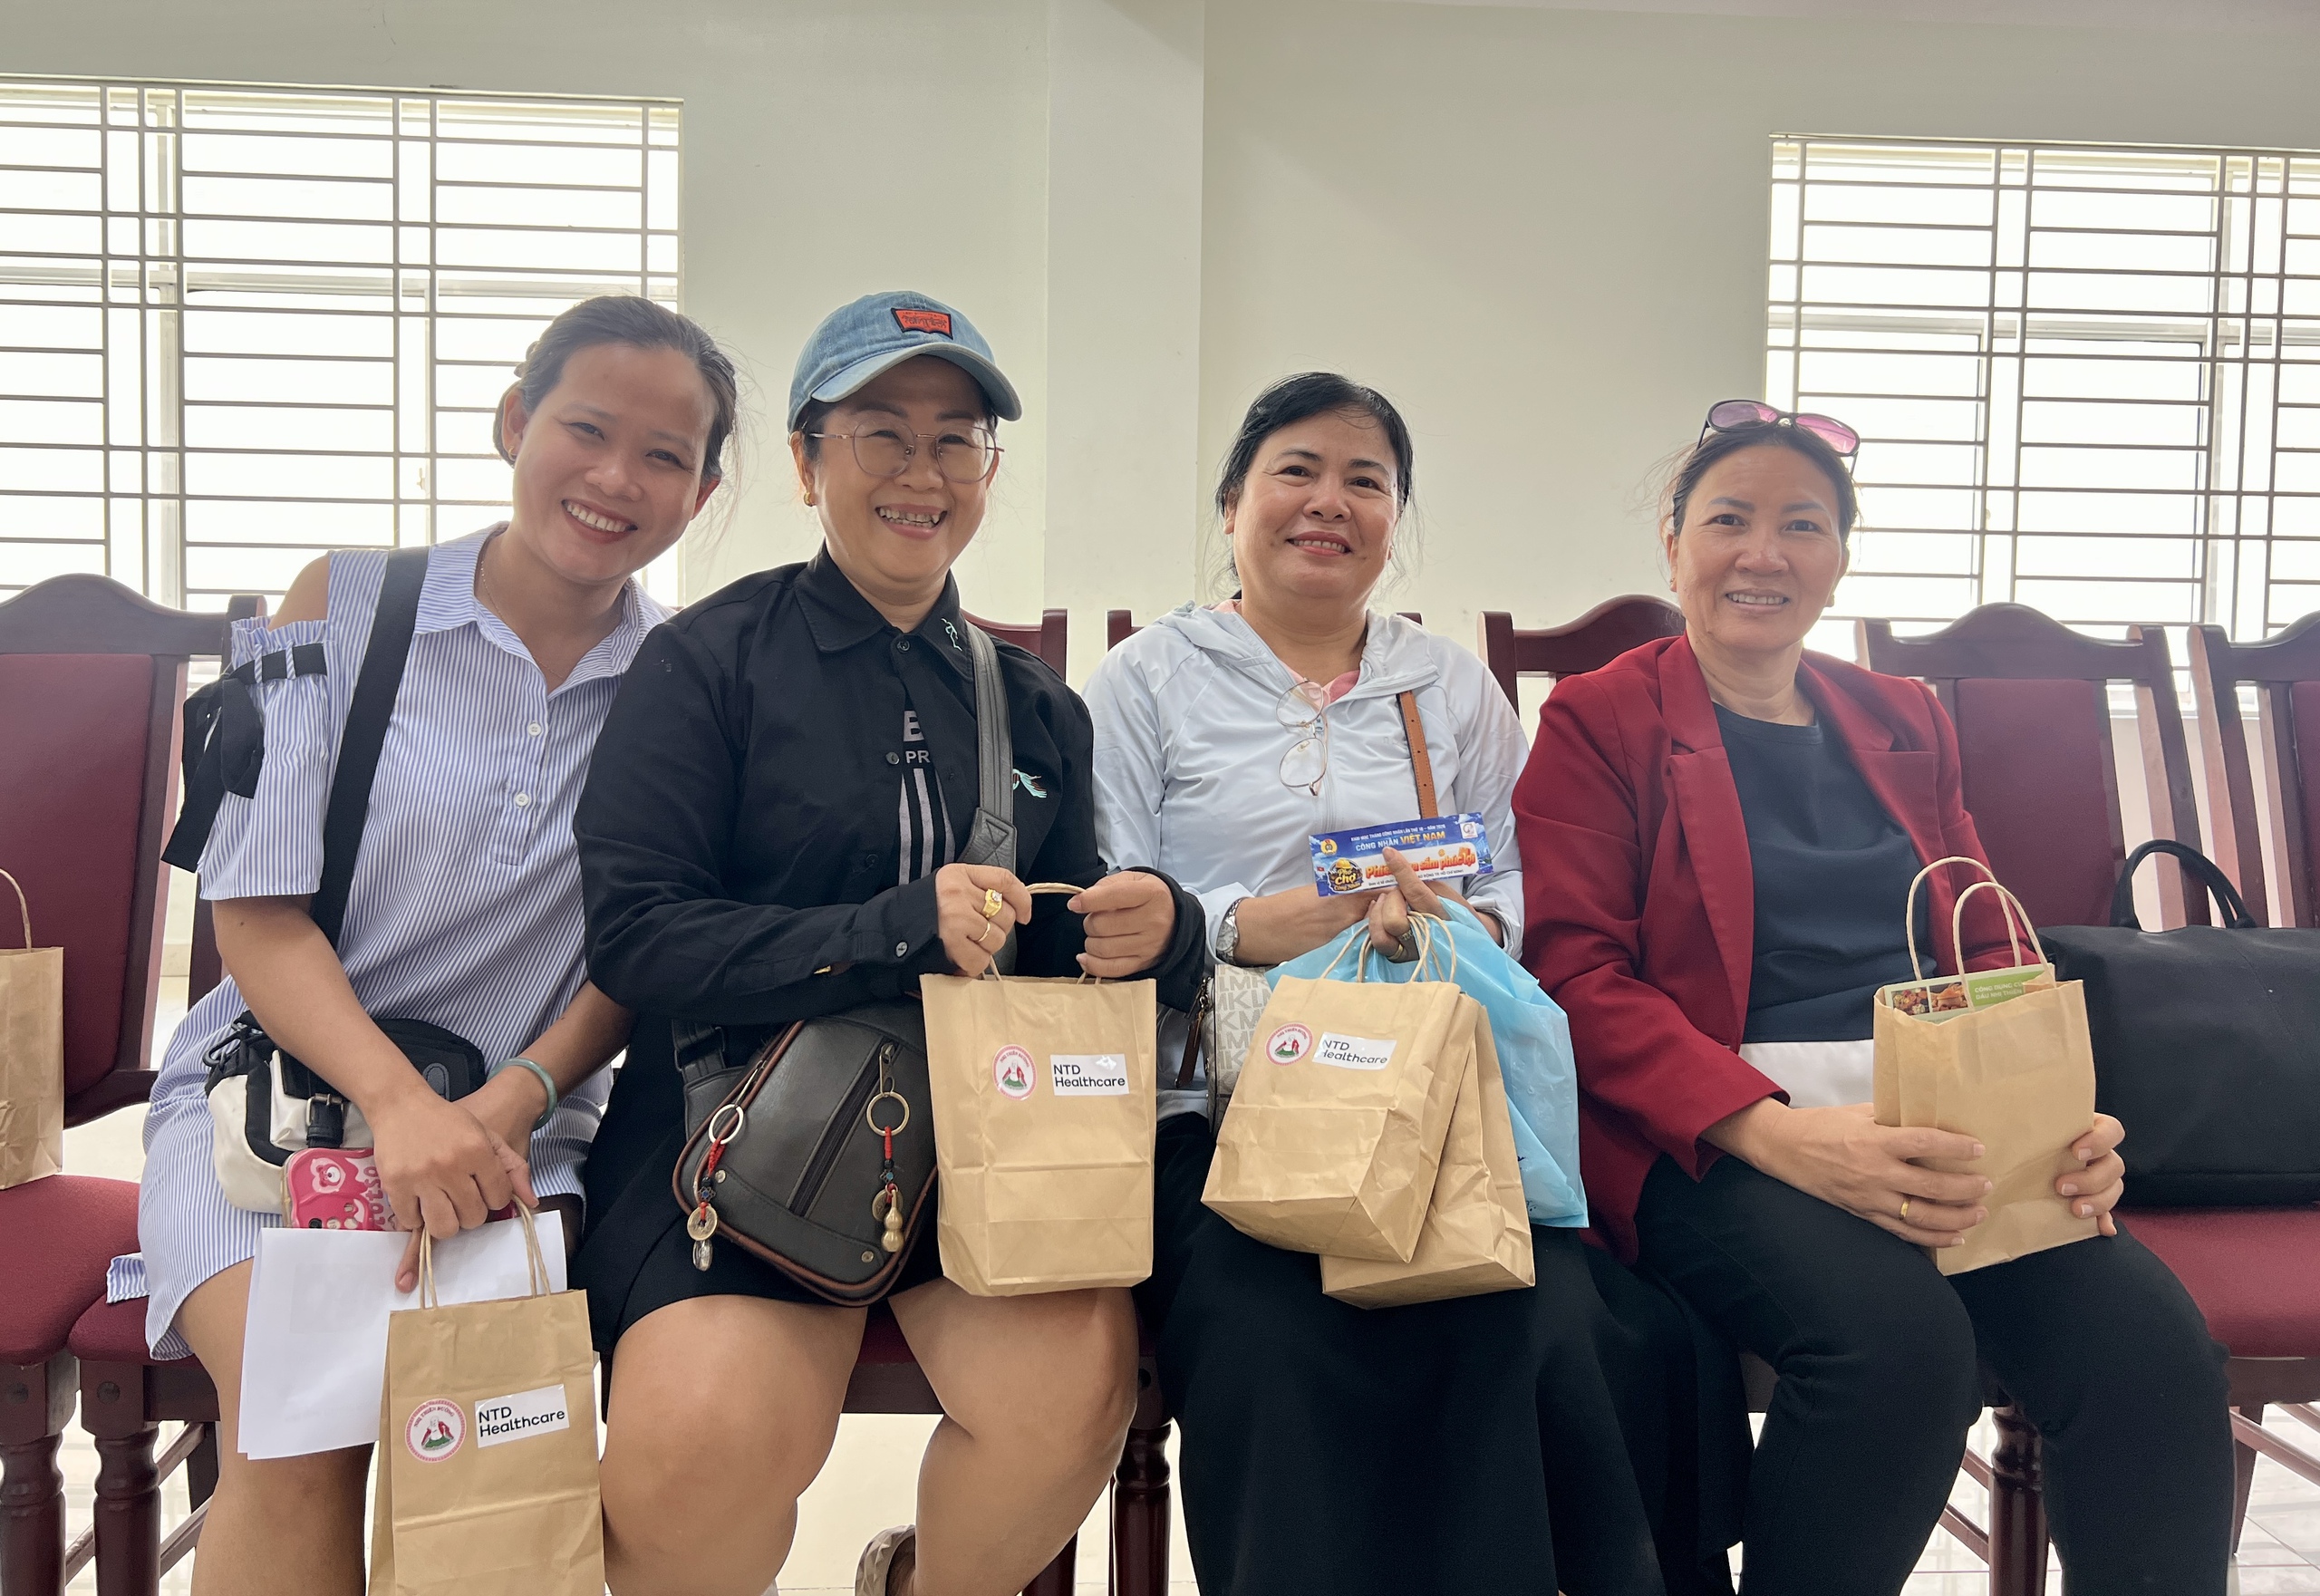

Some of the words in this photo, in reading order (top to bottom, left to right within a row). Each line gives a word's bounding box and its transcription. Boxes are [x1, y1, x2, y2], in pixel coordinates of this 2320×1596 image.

[1356, 842, 1376, 852] CÔNG
[1378, 837, 1399, 848] NHÂN
[1399, 832, 1421, 845] VIỆT
[1423, 831, 1445, 841] NAM
[1975, 985, 1993, 993] CÔNG
[1053, 1064, 1080, 1075] NTD
[1055, 1076, 1126, 1088] Healthcare
[478, 1406, 512, 1424] NTD
[479, 1410, 566, 1437] Healthcare
